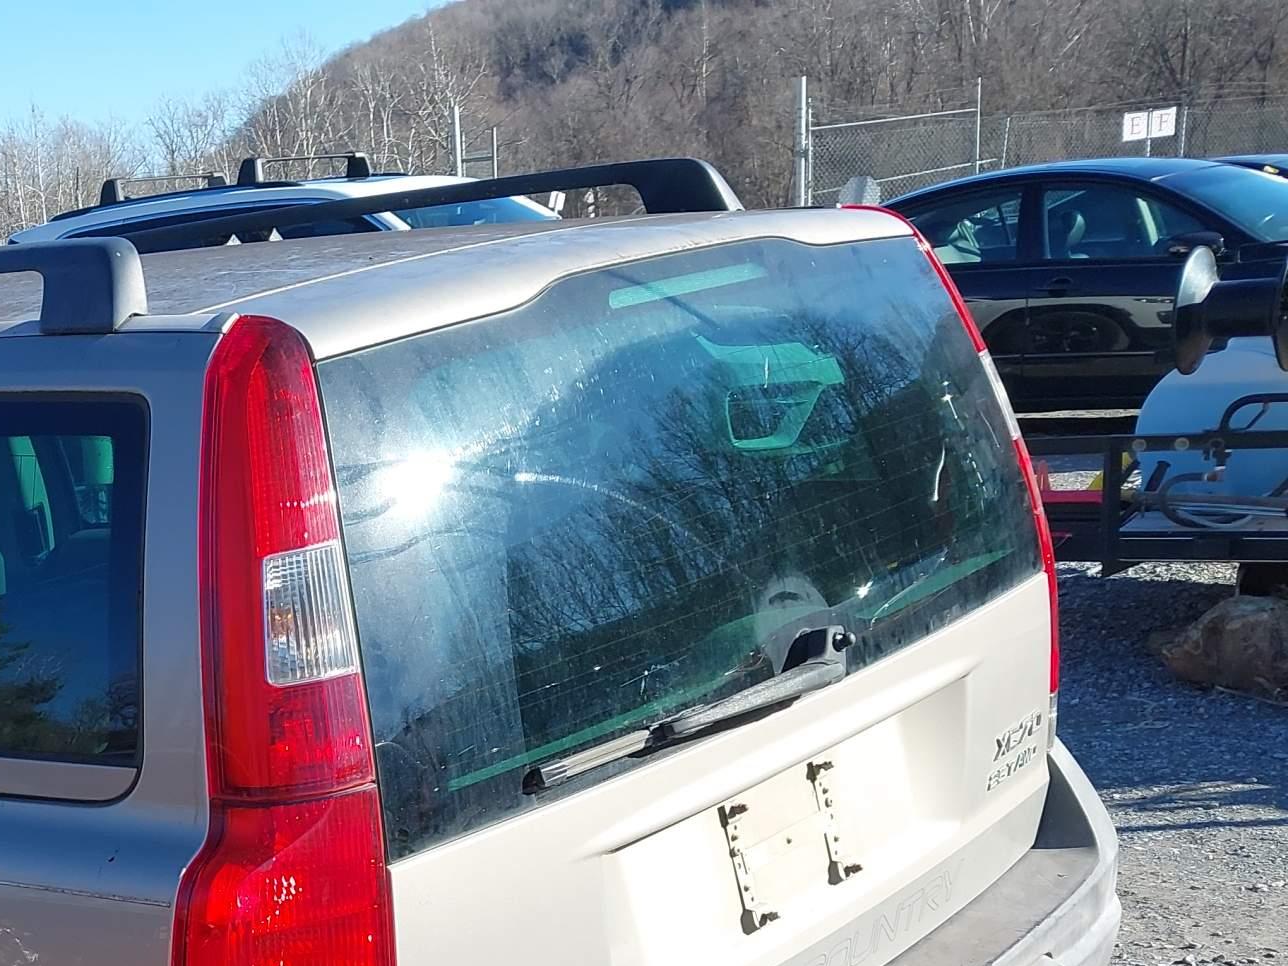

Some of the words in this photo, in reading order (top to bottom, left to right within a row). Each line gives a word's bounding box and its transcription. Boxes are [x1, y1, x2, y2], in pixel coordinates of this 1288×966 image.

[1130, 116, 1142, 135] E
[1158, 112, 1172, 132] F
[993, 711, 1042, 762] XC70
